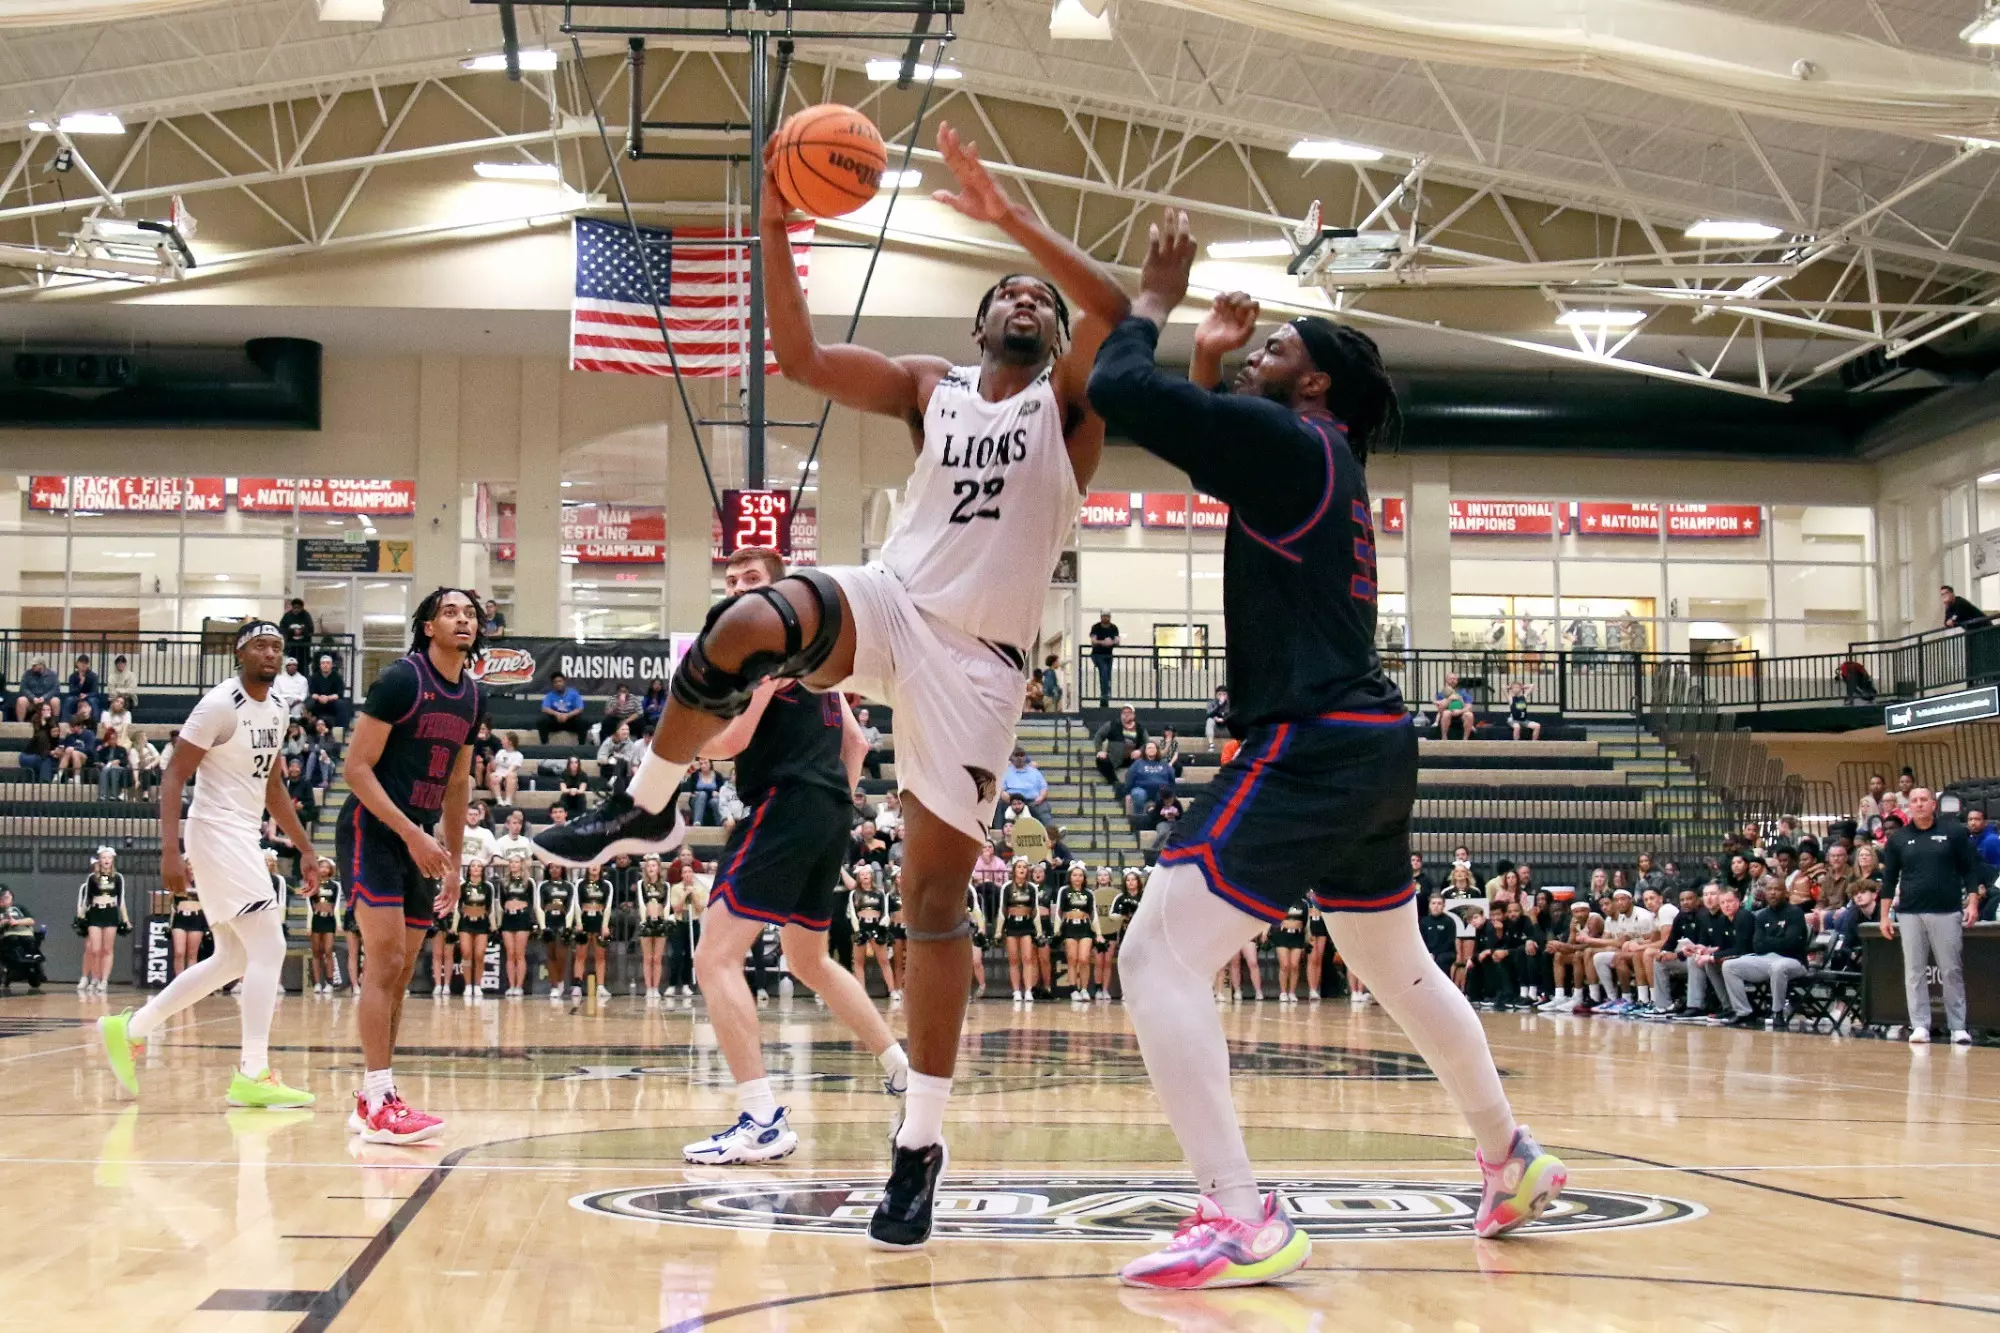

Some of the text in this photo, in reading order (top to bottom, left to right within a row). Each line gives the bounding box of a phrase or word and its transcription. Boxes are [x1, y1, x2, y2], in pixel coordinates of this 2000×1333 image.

[941, 428, 1027, 469] LIONS
[61, 478, 120, 494] TRACK
[142, 479, 195, 495] FIELD
[128, 495, 206, 511] CHAMPON
[332, 491, 409, 508] CHAMPION
[740, 495, 786, 515] 5:04
[949, 477, 1005, 524] 22
[598, 509, 631, 524] NAIA
[1468, 503, 1553, 516] INVITATIONAL
[1601, 514, 1738, 530] NATIONA CHAMPION
[561, 525, 628, 541] ESTLING
[736, 516, 777, 549] 23
[587, 544, 655, 557] CHAMPION
[561, 655, 635, 680] RAISING
[250, 728, 278, 749] LIONS
[148, 921, 170, 984] BLACK
